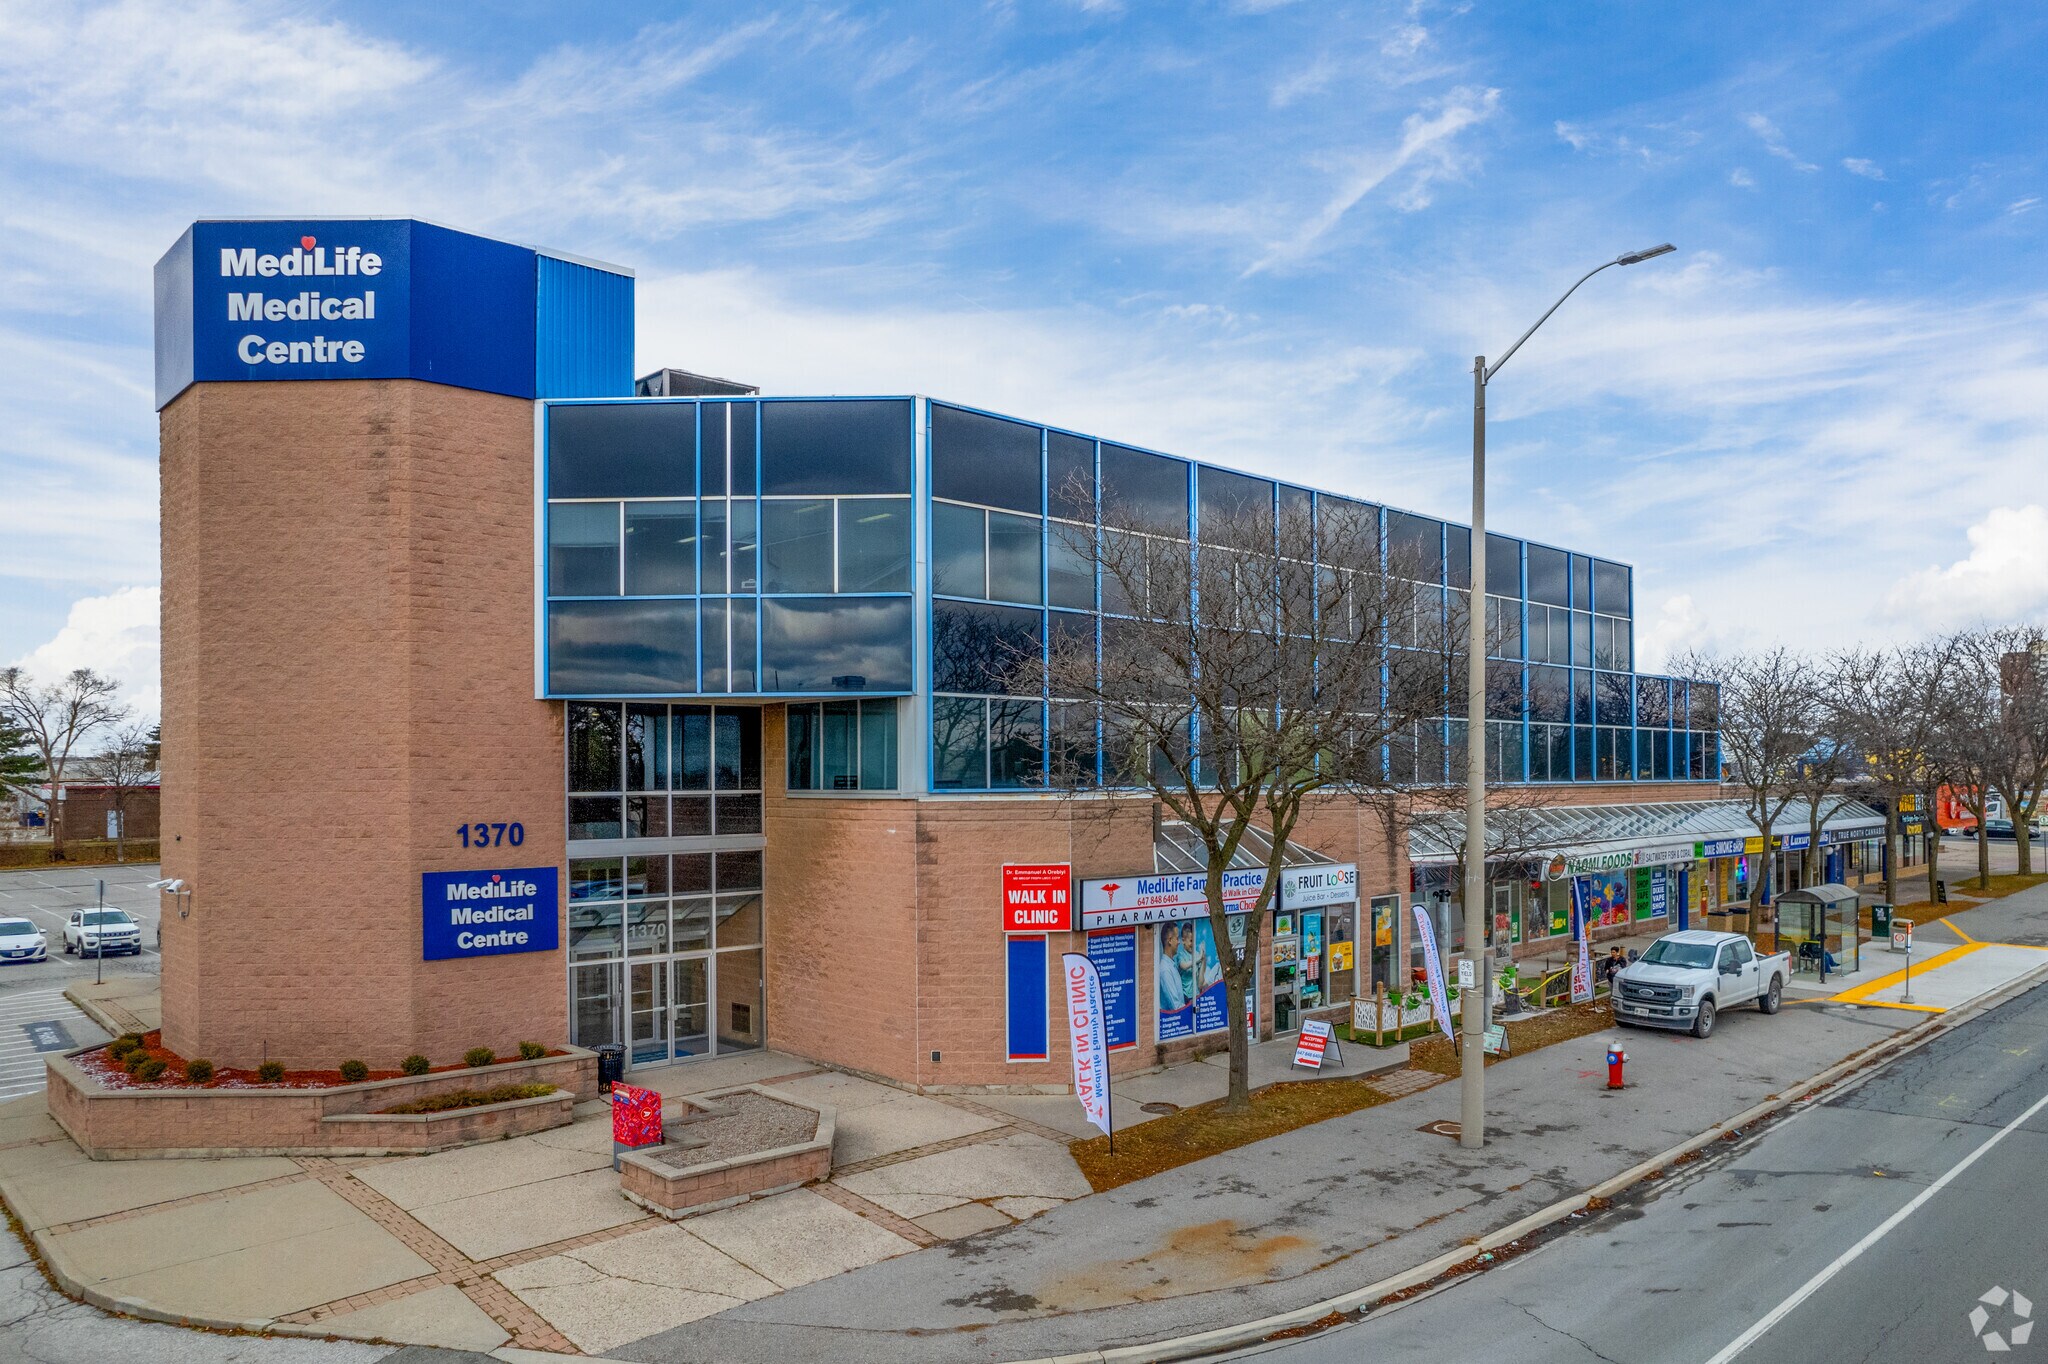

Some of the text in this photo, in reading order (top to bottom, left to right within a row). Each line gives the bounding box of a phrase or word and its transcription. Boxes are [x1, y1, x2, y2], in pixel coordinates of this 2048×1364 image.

[221, 246, 382, 276] MediLife
[228, 291, 375, 321] Medical
[238, 334, 365, 364] Centre
[456, 822, 524, 848] 1370
[1850, 830, 1864, 838] NORTH
[1646, 851, 1667, 862] SALTWATER
[1668, 850, 1676, 859] FISH
[1680, 849, 1692, 858] CORAL
[1705, 844, 1715, 855] DIXIE
[1716, 841, 1733, 854] SMOKE
[1733, 842, 1743, 852] SHOP
[1602, 852, 1632, 869] FOODS
[1137, 872, 1261, 895] MediLife Fam Practice
[1299, 870, 1354, 889] FRUIT LOOSE
[1637, 880, 1648, 888] SHOP
[447, 880, 537, 900] MediLife
[1008, 890, 1066, 904] WALK IN
[1228, 889, 1240, 897] Walk
[1652, 886, 1664, 894] DIXIE
[1652, 894, 1665, 902] VAPE
[1137, 894, 1178, 906] 647 848 6404
[451, 904, 534, 925] Medical
[1014, 910, 1058, 924] CLINIC
[1097, 907, 1188, 926] PHARMACY
[629, 923, 666, 939] 1370
[457, 930, 528, 949] Centre
